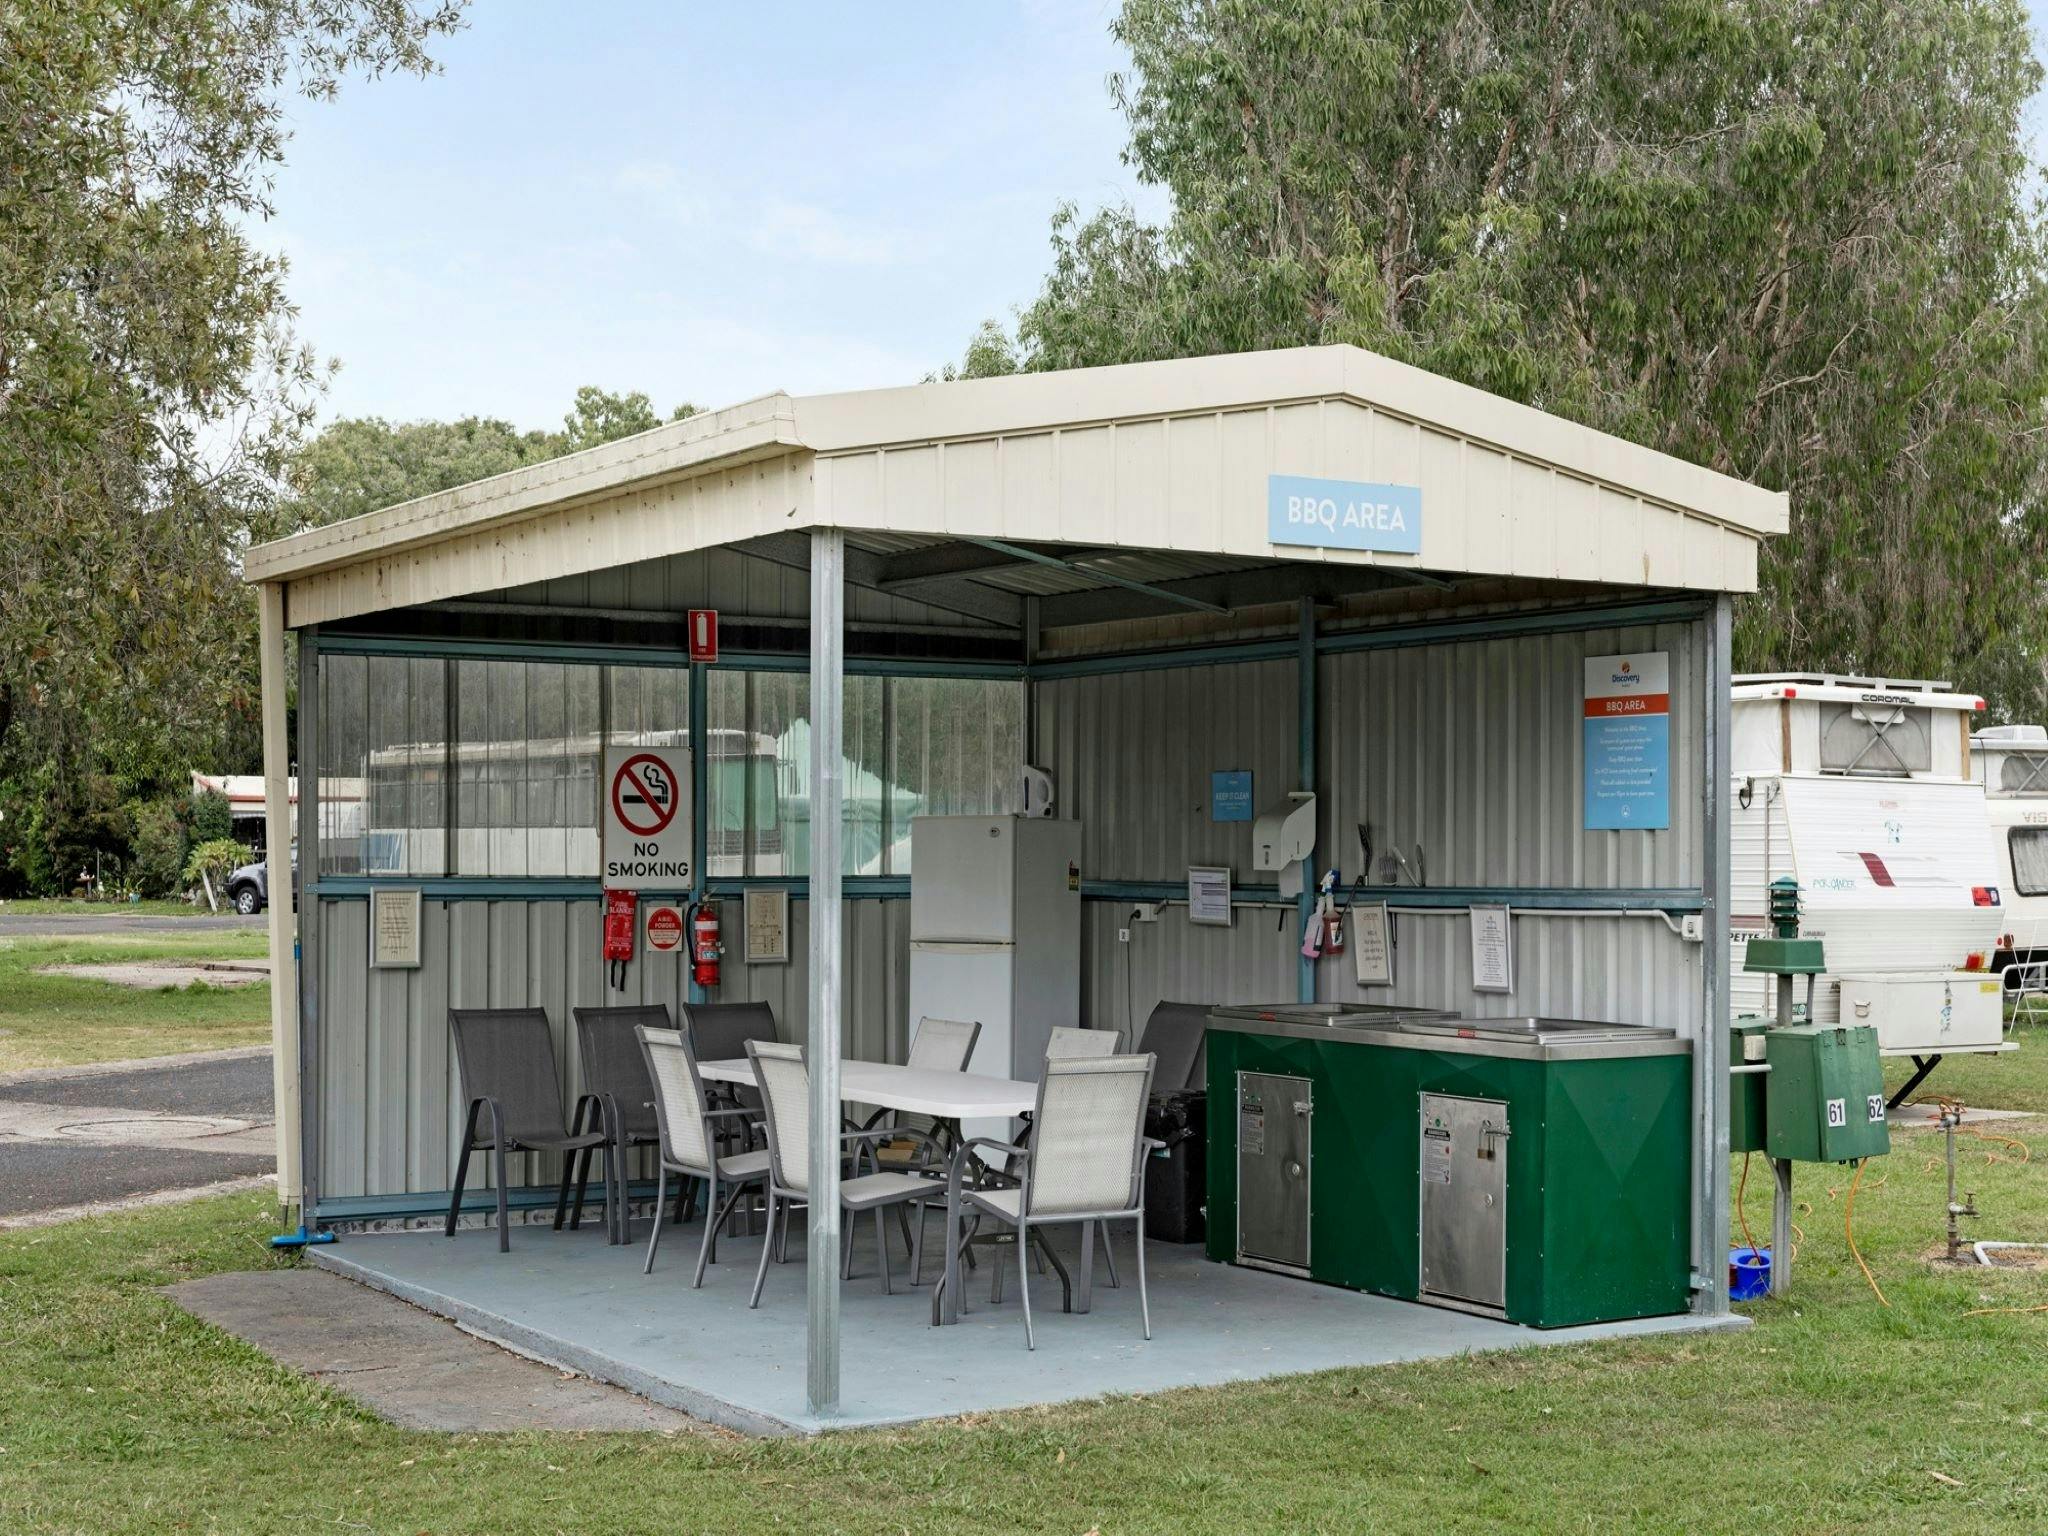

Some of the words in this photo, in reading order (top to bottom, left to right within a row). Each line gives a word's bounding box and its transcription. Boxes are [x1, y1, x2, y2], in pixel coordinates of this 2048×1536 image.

[1288, 495, 1337, 533] BBQ
[1342, 502, 1406, 532] AREA
[1612, 674, 1640, 683] Discovery
[1861, 693, 1916, 705] COROMAL
[1606, 701, 1623, 713] BBQ
[1624, 700, 1646, 711] AREA
[633, 843, 659, 857] NO
[607, 862, 689, 877] SMOKING
[1829, 1103, 1843, 1123] 61
[1868, 1098, 1883, 1118] 62
